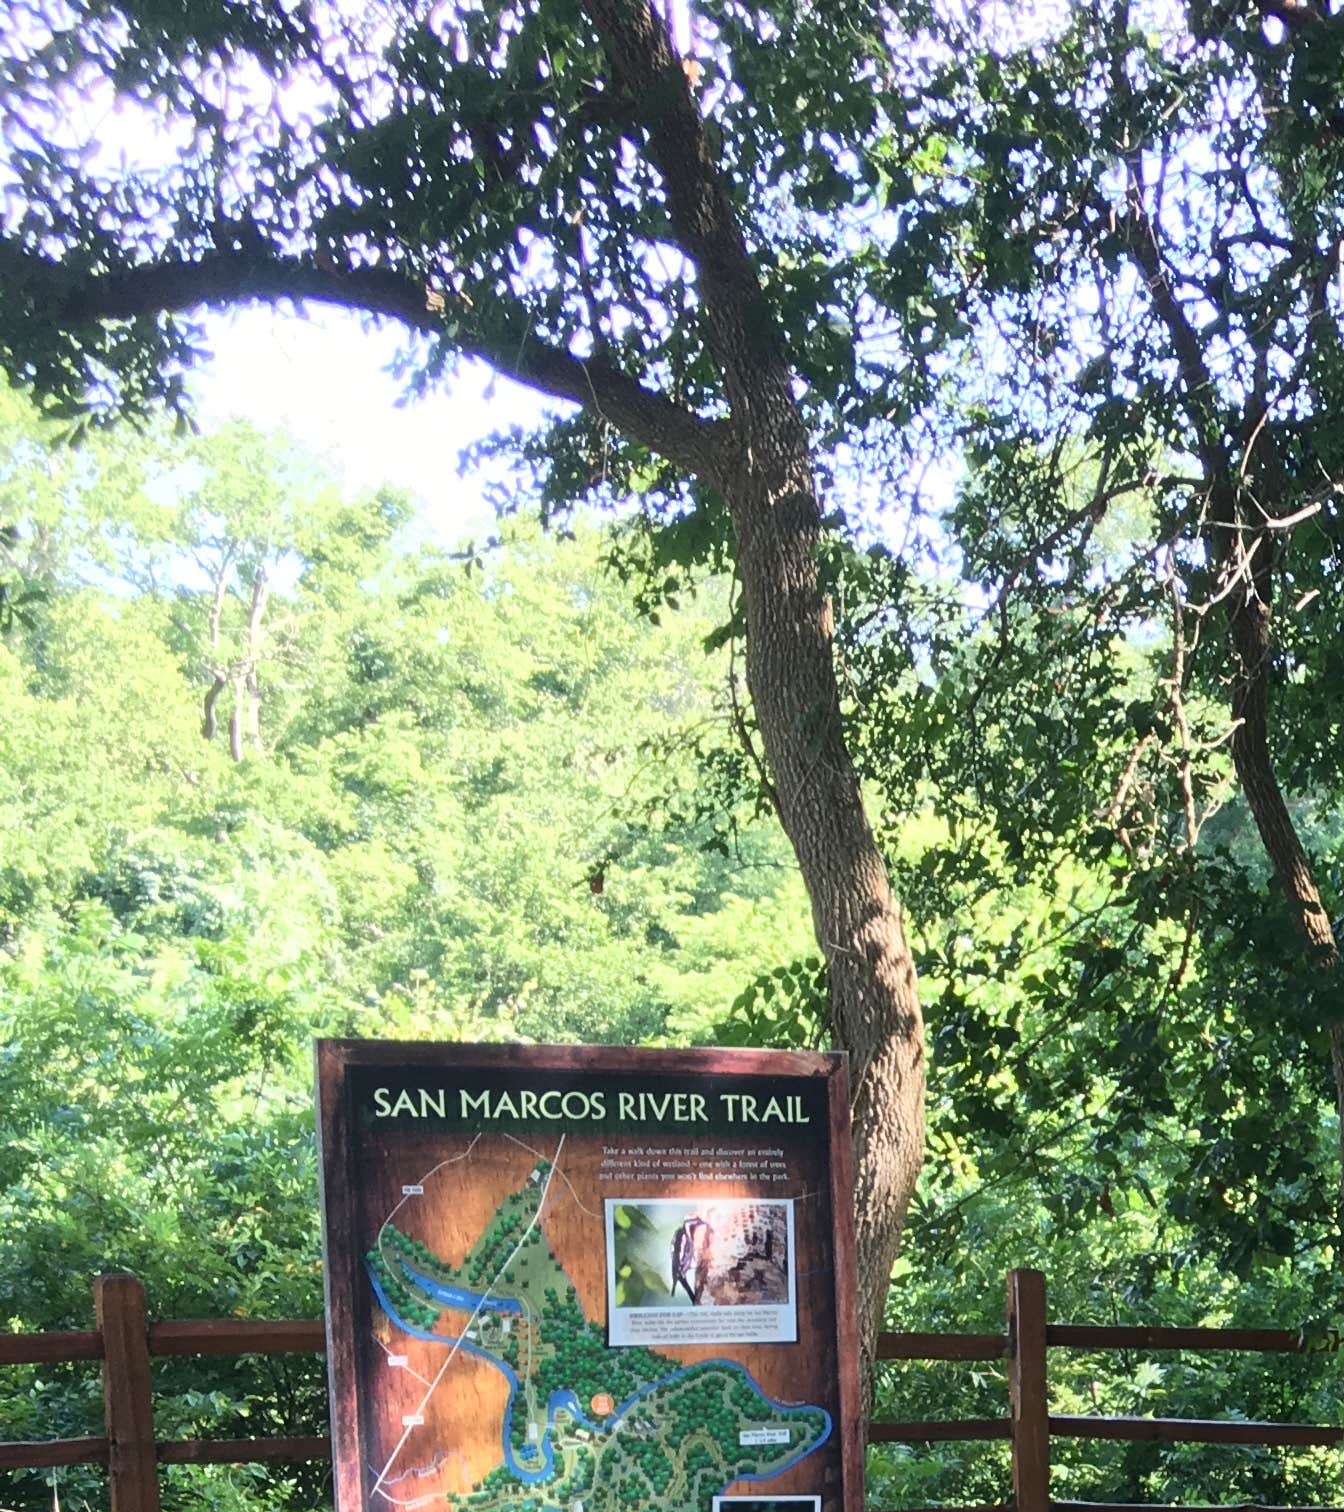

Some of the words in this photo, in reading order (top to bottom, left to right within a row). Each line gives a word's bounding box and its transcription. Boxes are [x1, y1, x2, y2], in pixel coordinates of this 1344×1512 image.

[374, 1088, 446, 1118] SAN
[459, 1089, 606, 1120] MARCOS
[618, 1092, 709, 1122] RIVER
[720, 1094, 810, 1123] TRAIL
